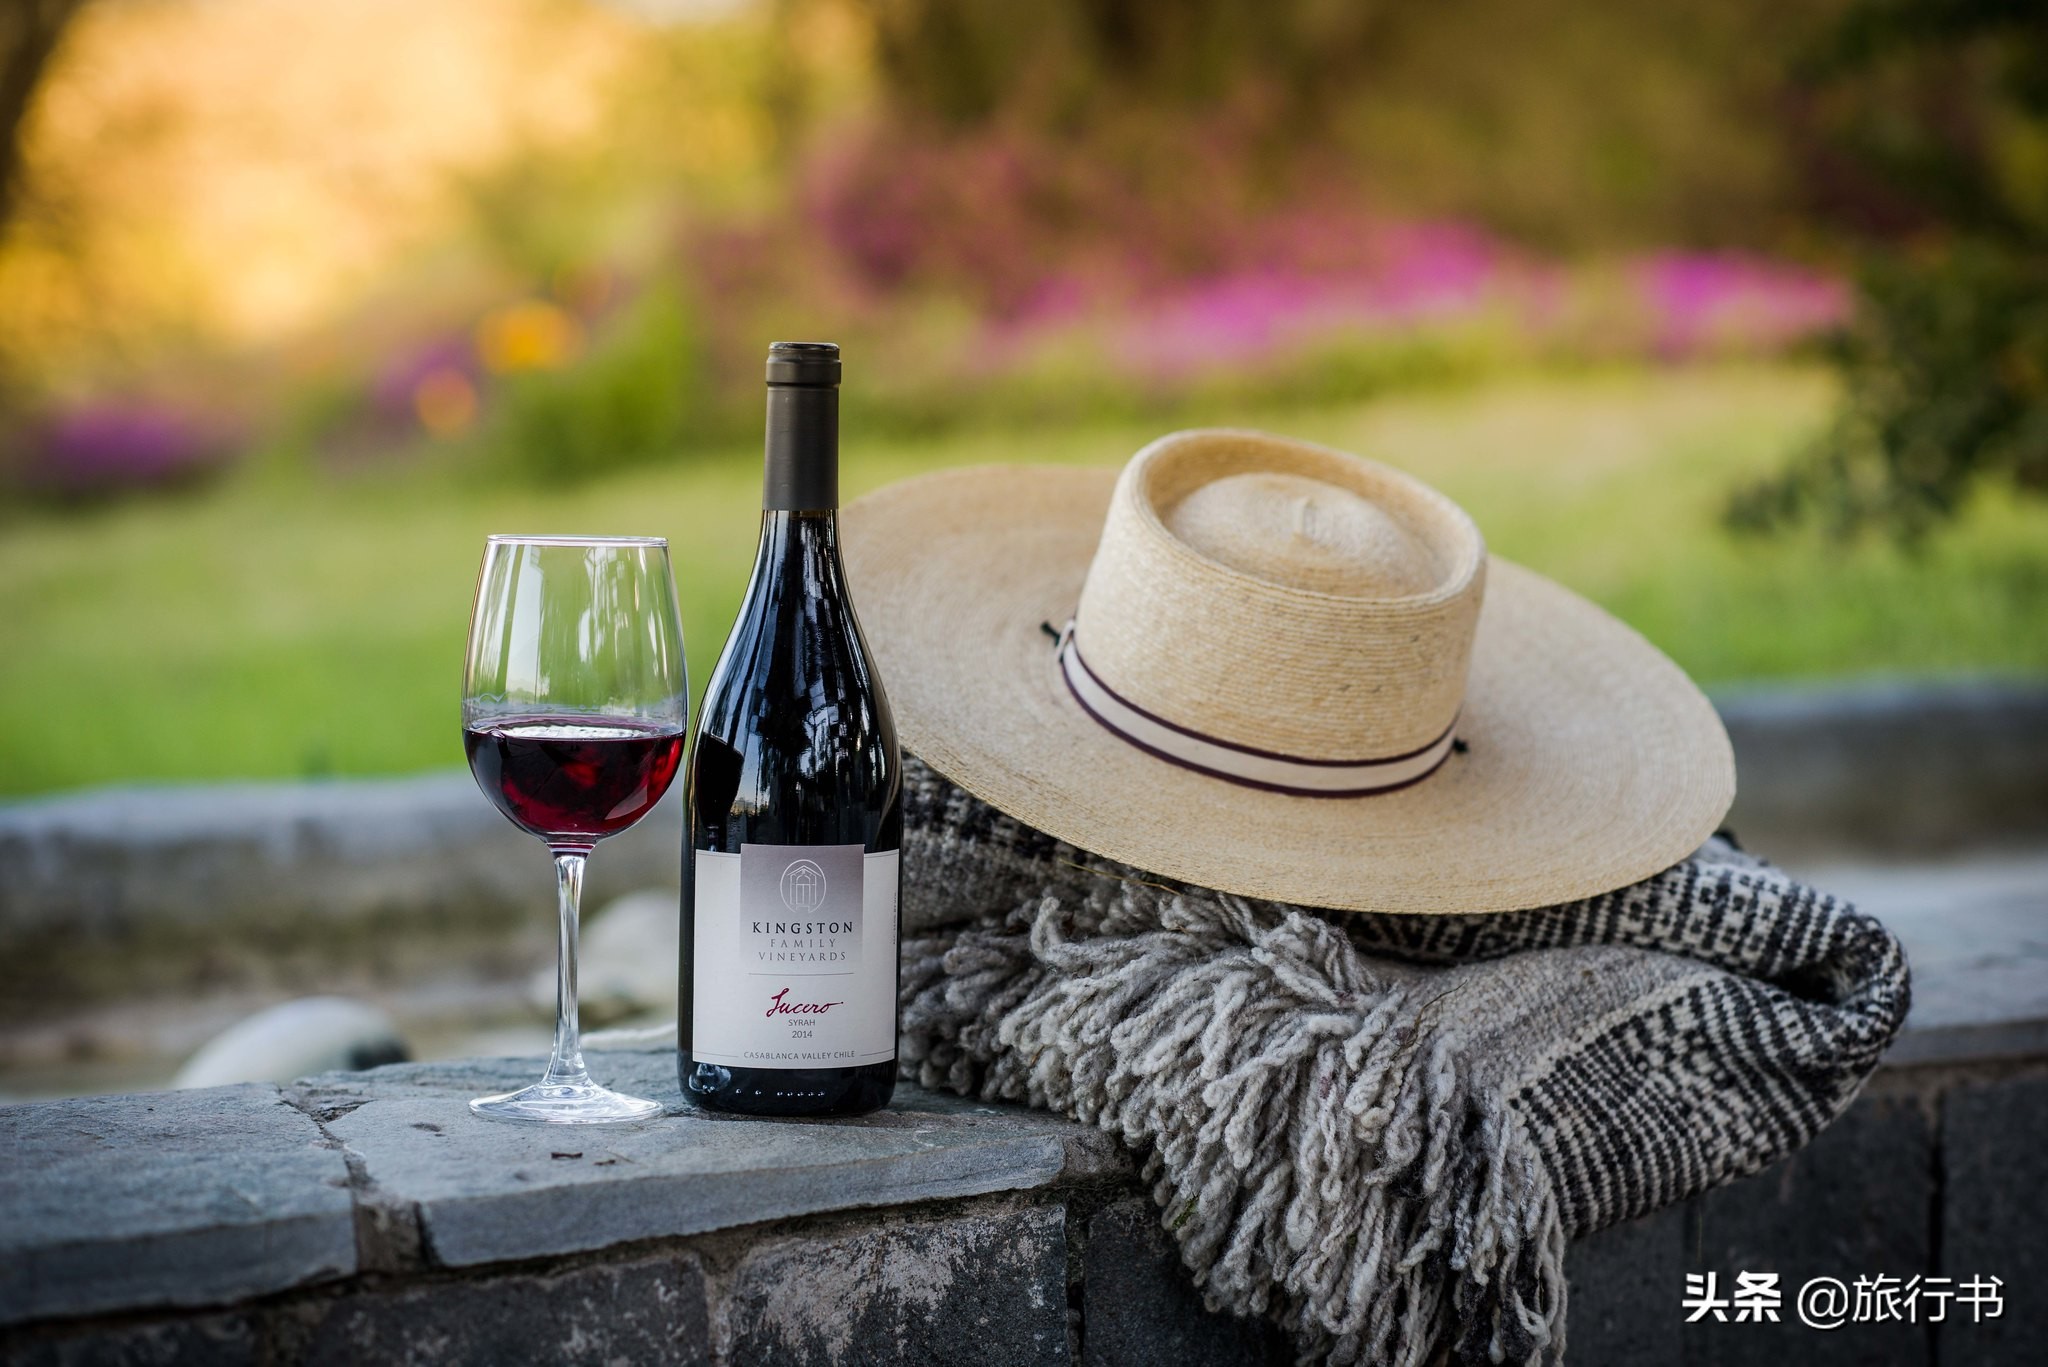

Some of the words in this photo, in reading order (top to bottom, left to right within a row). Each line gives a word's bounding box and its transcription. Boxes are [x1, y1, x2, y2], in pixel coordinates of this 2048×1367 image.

[752, 921, 853, 934] KINGSTON
[770, 939, 836, 948] FAMILY
[758, 951, 846, 961] VINEYARDS
[766, 988, 844, 1017] Lucero
[788, 1019, 816, 1027] SYRAH
[792, 1030, 813, 1039] 2014
[743, 1051, 799, 1060] CASABLANCA
[802, 1052, 832, 1060] VALLEY
[834, 1050, 855, 1058] CHILE
